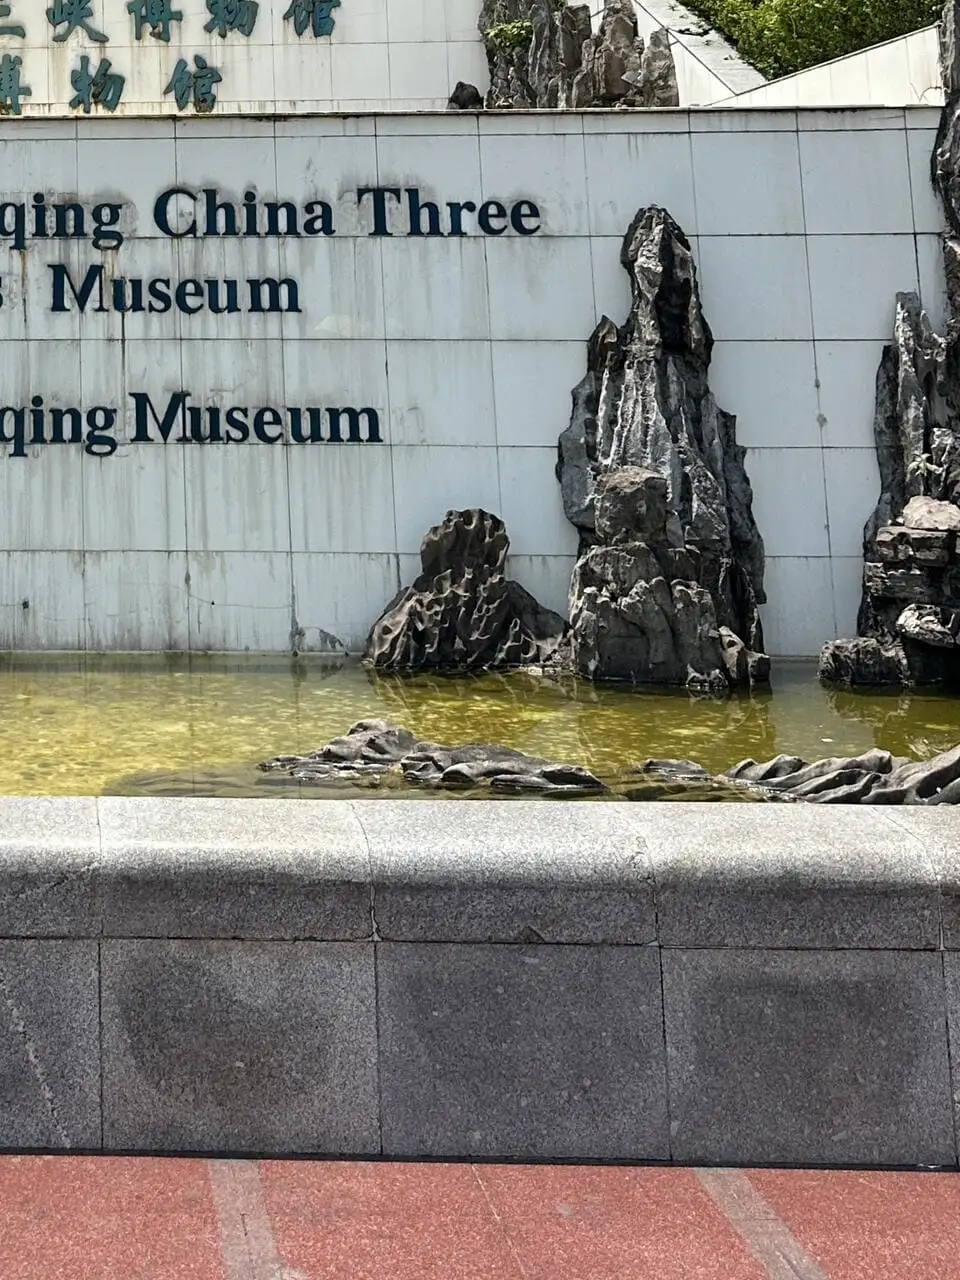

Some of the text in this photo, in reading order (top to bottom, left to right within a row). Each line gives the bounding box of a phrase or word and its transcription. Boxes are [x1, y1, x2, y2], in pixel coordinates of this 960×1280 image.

[154, 189, 336, 236] China
[358, 188, 542, 235] Three
[48, 264, 302, 312] Museum
[130, 392, 384, 443] Museum
